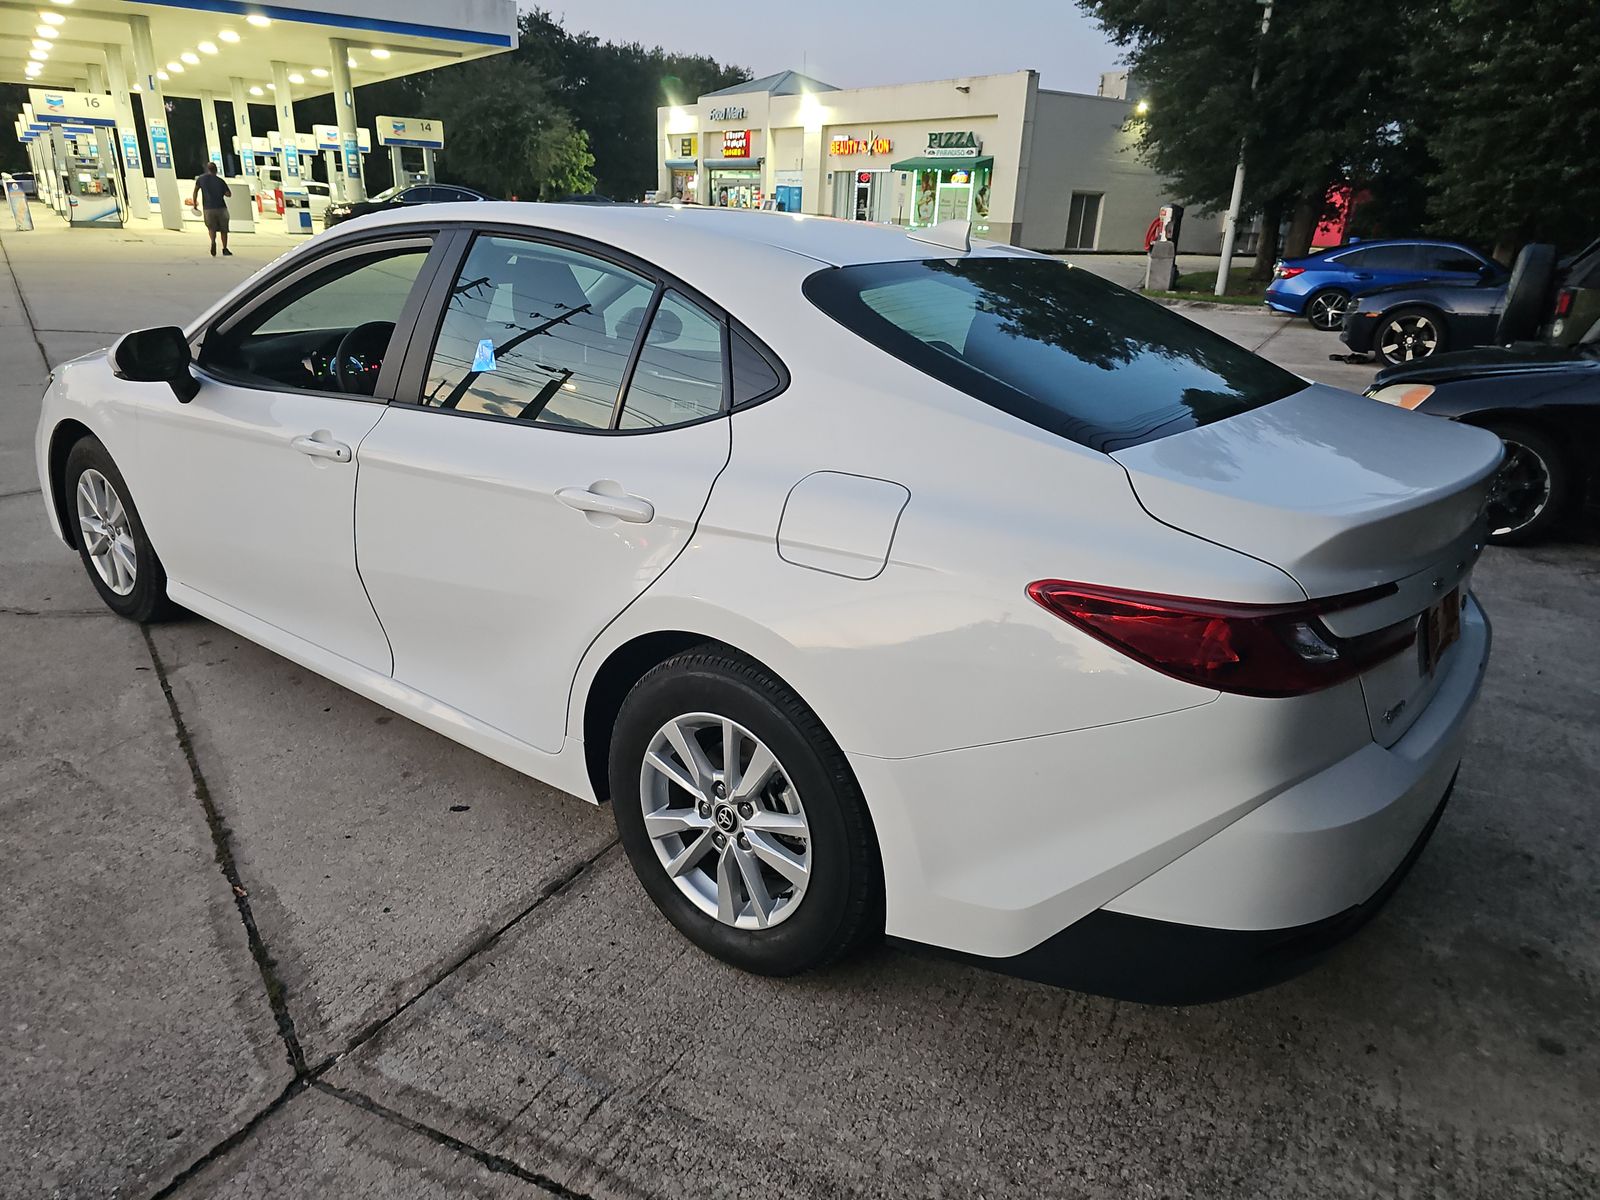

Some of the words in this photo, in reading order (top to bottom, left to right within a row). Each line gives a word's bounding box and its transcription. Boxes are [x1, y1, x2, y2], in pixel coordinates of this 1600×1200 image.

[84, 97, 100, 108] 16
[710, 108, 727, 120] Food
[728, 107, 745, 120] Mart
[420, 122, 431, 132] 14
[927, 131, 977, 148] PIZZA
[831, 140, 859, 154] BEAUTY
